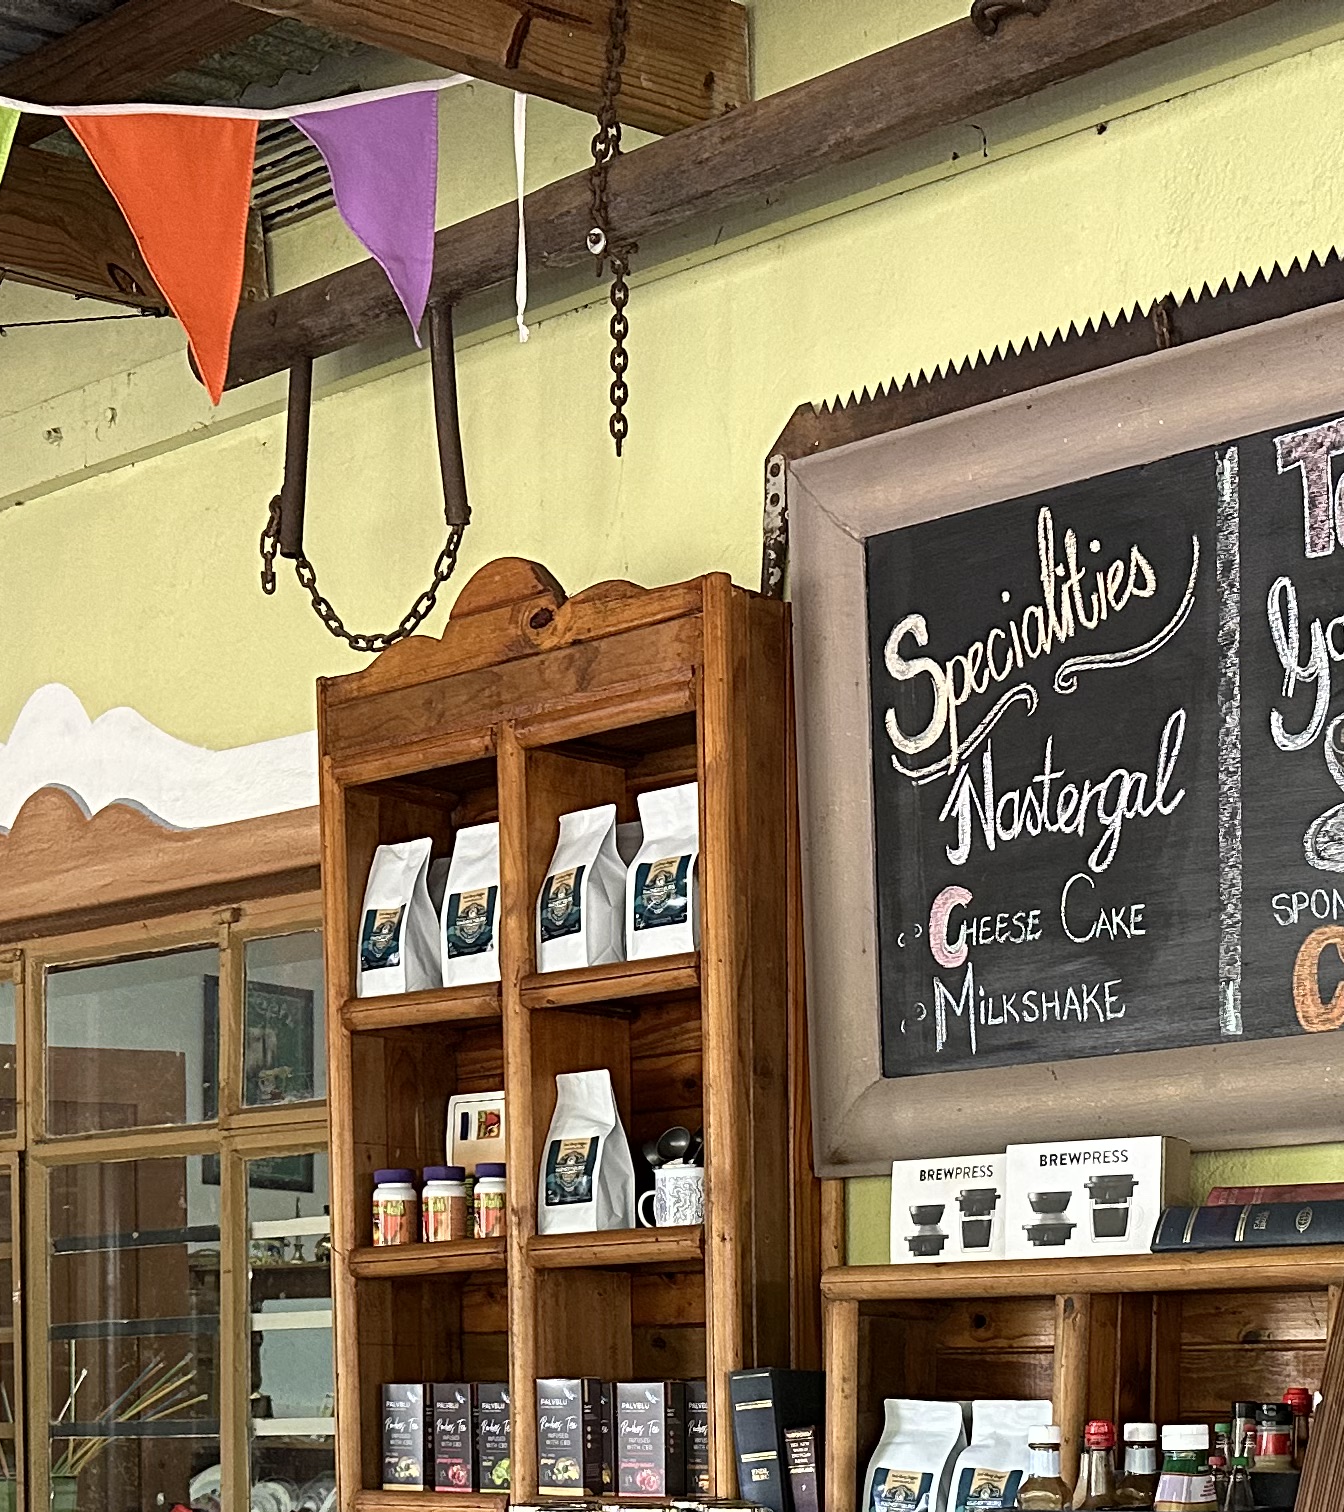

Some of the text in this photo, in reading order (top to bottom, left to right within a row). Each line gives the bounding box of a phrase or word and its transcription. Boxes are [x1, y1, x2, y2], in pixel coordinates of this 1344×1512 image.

[884, 507, 1156, 775] Specialities
[940, 707, 1187, 874] Nastergal
[919, 1165, 994, 1183] BREWPRESS
[1038, 1148, 1129, 1168] BREWPRESS
